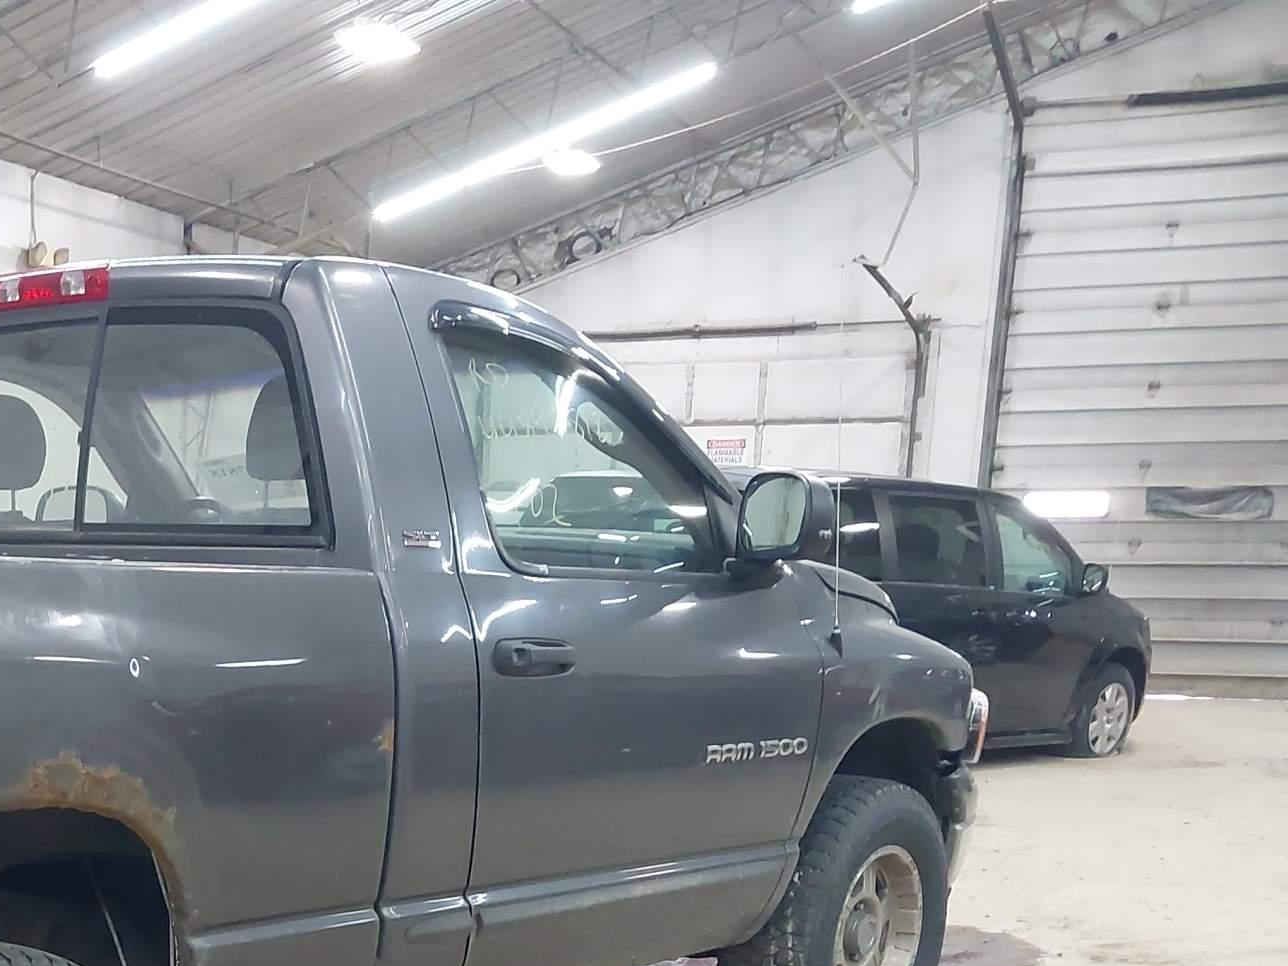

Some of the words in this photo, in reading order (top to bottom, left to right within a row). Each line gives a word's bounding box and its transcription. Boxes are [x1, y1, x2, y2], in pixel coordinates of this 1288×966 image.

[707, 448, 745, 456] FLAMMABLE
[705, 742, 754, 764] RAM
[759, 737, 809, 759] 1500
